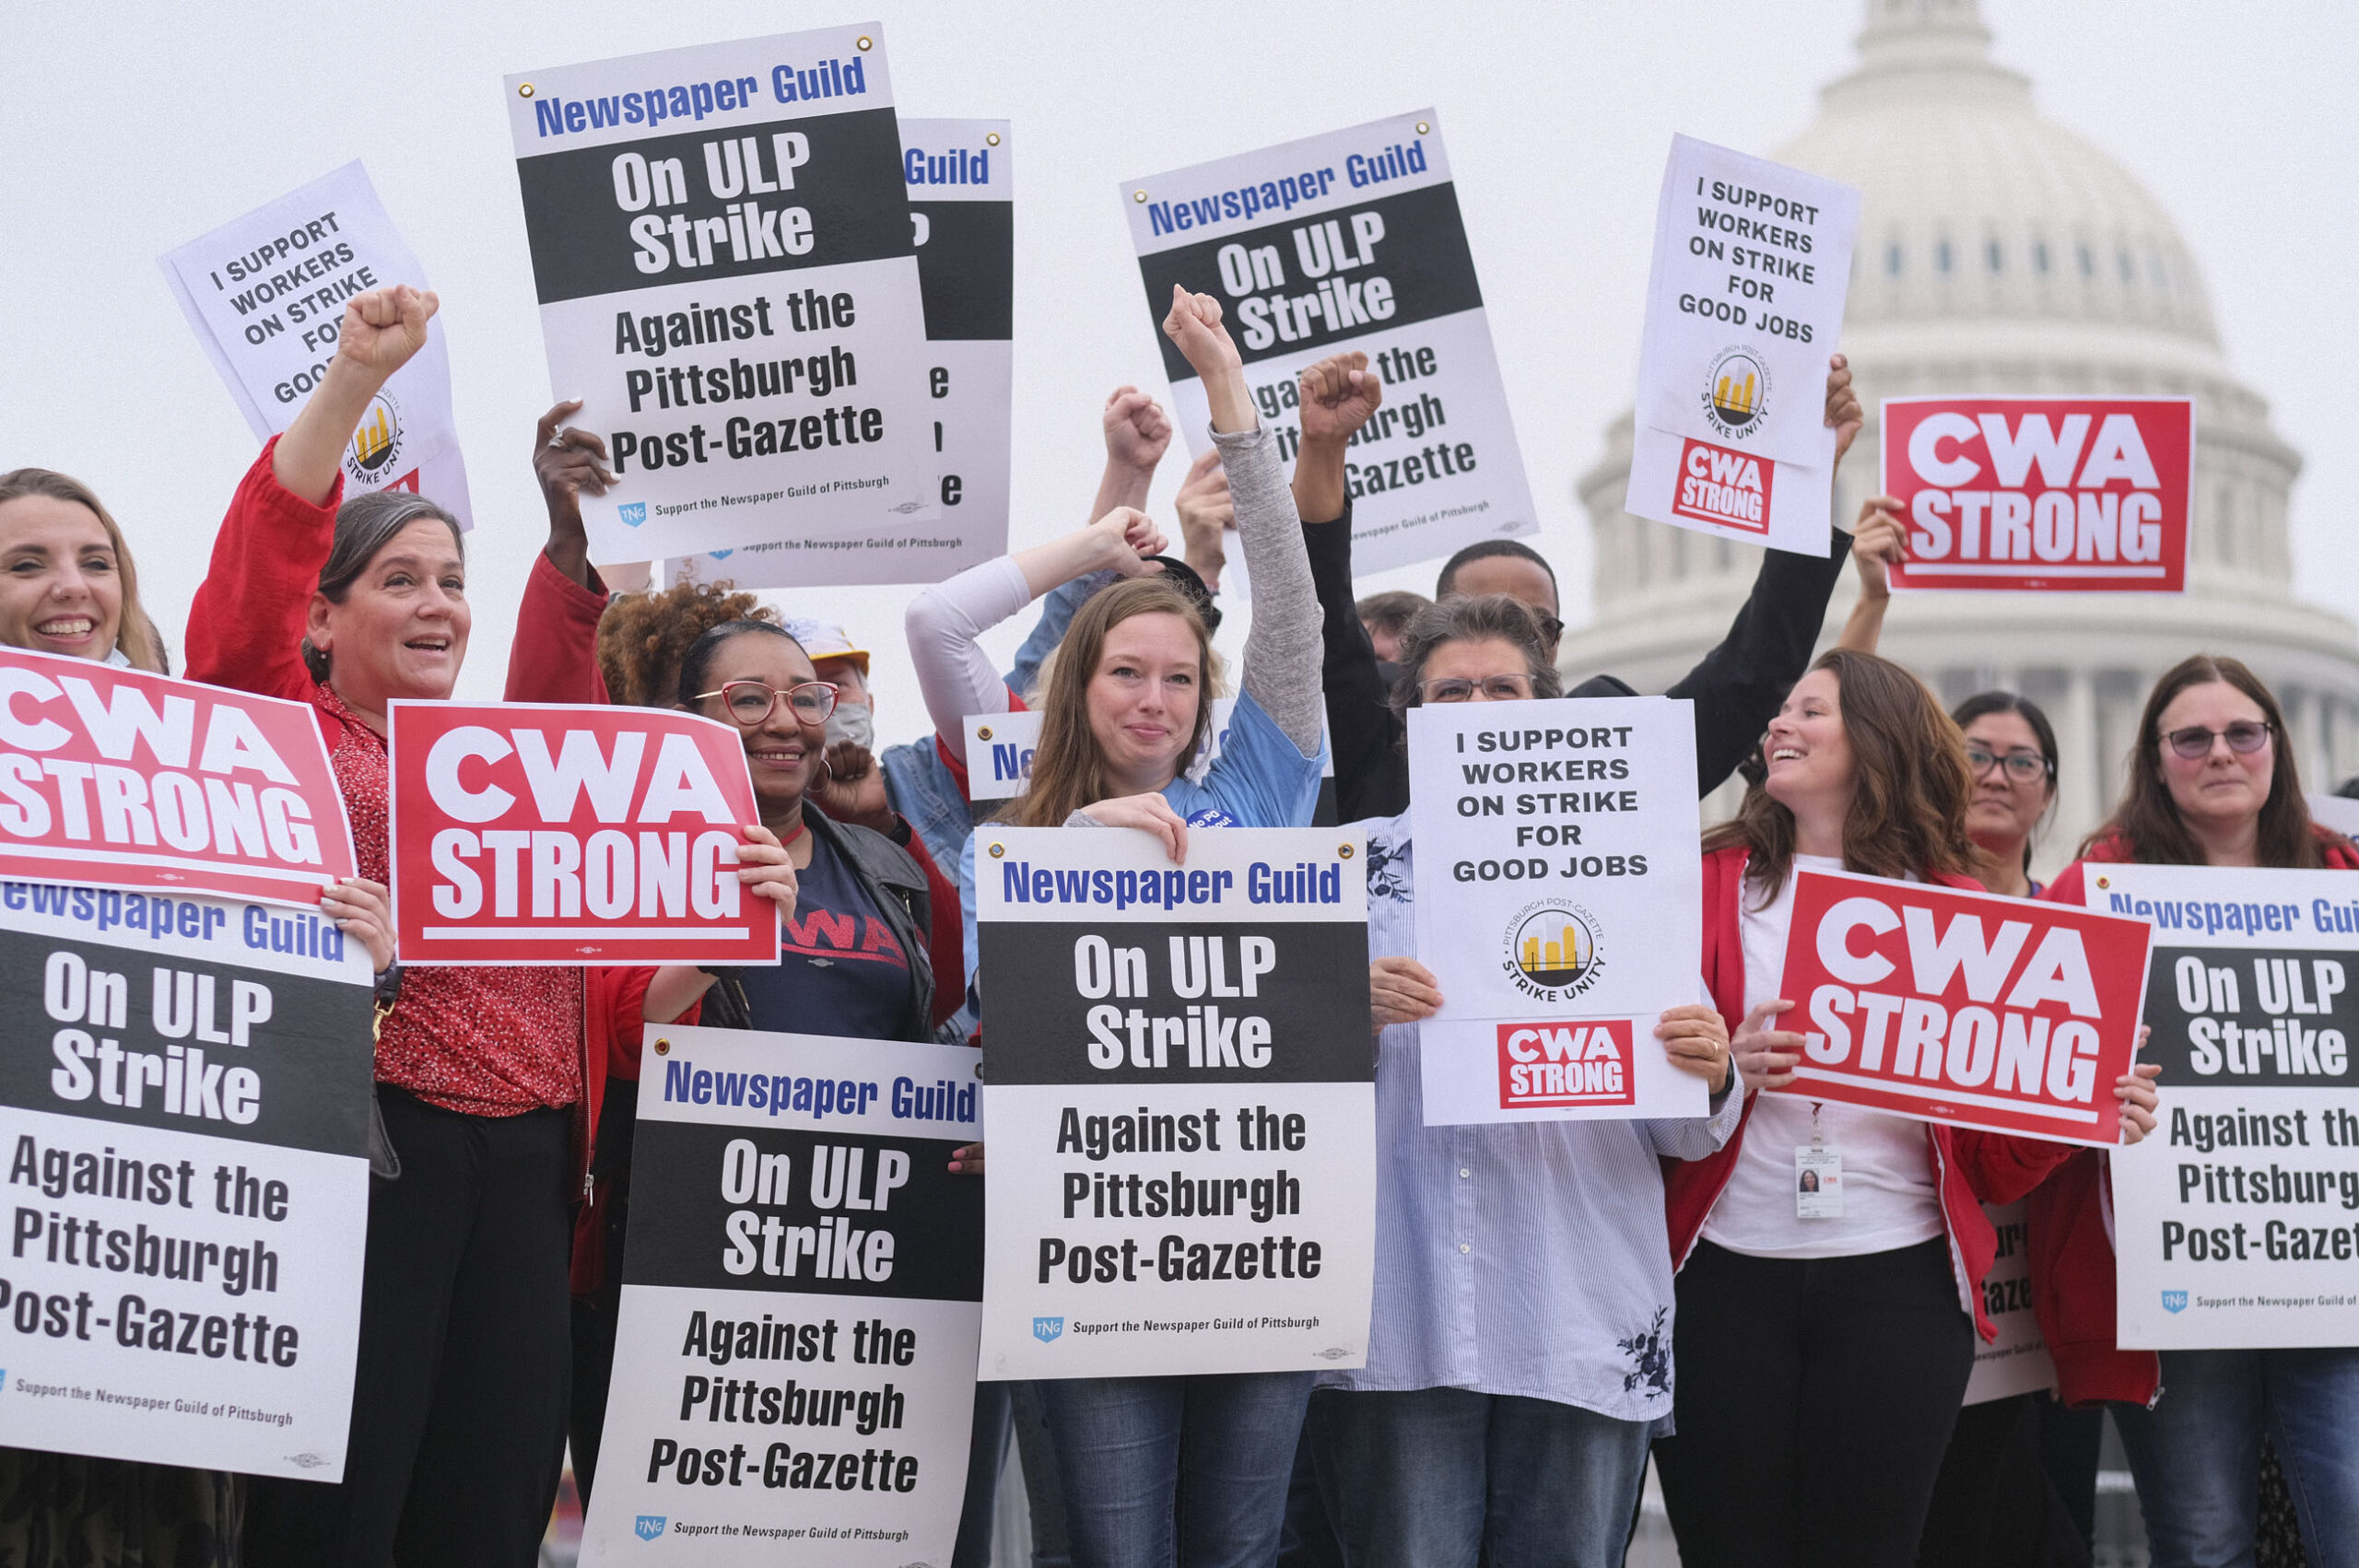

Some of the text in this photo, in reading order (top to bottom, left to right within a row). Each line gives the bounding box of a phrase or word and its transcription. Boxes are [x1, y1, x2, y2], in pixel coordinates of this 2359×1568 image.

[534, 56, 866, 138] Newspaper Guild
[612, 132, 811, 212] On ULP
[905, 148, 990, 184] Guild
[1147, 140, 1427, 237] Newspaper Guild
[1696, 177, 1819, 226] I SUPPORT
[209, 211, 340, 290] I SUPPORT
[630, 202, 815, 275] Strike
[1217, 211, 1385, 298] On ULP
[1697, 207, 1813, 253] WORKERS
[230, 242, 355, 315] WORKERS
[1689, 237, 1815, 286] ON STRIKE
[1728, 275, 1774, 303] FOR
[244, 266, 378, 345] ON STRIKE
[615, 289, 855, 357] Against the
[1237, 276, 1395, 350] Strike
[1679, 293, 1813, 344] GOOD JOBS
[275, 356, 337, 403] GOO
[626, 346, 857, 413] Pittsburgh
[1378, 345, 1438, 385] the
[612, 407, 884, 474] Post-Gazette
[1701, 392, 1768, 439] STRIKE UNITY
[346, 457, 380, 485] STRIKE
[383, 427, 404, 475] UNITY
[1344, 441, 1476, 499] Gazette
[1686, 446, 1764, 494] CWA
[1907, 413, 2161, 489] CWA
[621, 506, 645, 521] TNG
[656, 476, 890, 517] Support the Newspaper Guild of Pittsburgh
[1402, 516, 1427, 530] Guild
[1430, 512, 1439, 522] of
[1441, 501, 1489, 520] Pittsburgh
[1681, 479, 1764, 521] STRONG
[785, 540, 802, 550] the
[804, 539, 863, 551] Newspaper
[866, 538, 894, 549] Guild
[898, 538, 907, 548] of
[910, 538, 962, 551] Pittsburgh
[1911, 489, 2162, 562] STRONG
[0, 667, 300, 786] CWA
[1456, 726, 1633, 754] I SUPPORT
[426, 726, 737, 824] CWA
[1461, 759, 1629, 785] WORKERS
[0, 754, 323, 864] STRONG
[1457, 790, 1638, 817] ON STRIKE
[1517, 825, 1581, 848] FOR
[431, 829, 741, 919] STRONG
[1003, 861, 1341, 910] Newspaper Guild
[1452, 855, 1648, 882] GOOD JOBS
[4, 883, 344, 962] ewspaper Guild
[785, 908, 909, 965] WA
[1503, 897, 1603, 945] PITTSBURGH POST-GAZETTE
[2109, 894, 2359, 936] Newspaper Gui
[1074, 934, 1275, 999] On ULP
[1503, 956, 1605, 1002] STRIKE UNITY
[1816, 897, 2101, 1019] CWA
[2175, 954, 2345, 1015] On ULP
[44, 951, 273, 1047] On ULP
[1086, 1004, 1272, 1071] Strike
[1508, 1027, 1622, 1062] CWA
[1804, 984, 2099, 1104] STRONG
[2188, 1017, 2348, 1076] Strike
[51, 1028, 261, 1125] Strike
[663, 1060, 975, 1122] Newspaper Guild
[1509, 1061, 1623, 1094] STRONG
[1057, 1106, 1306, 1161] Against the
[2170, 1107, 2359, 1153] Against th
[9, 1135, 289, 1223] Against the
[721, 1139, 910, 1211] On ULP
[1063, 1170, 1299, 1223] Pittsburgh
[2178, 1163, 2359, 1210] Pittsburg
[13, 1208, 278, 1297] Pittsburgh
[723, 1211, 895, 1282] Strike
[1039, 1235, 1321, 1284] Post-Gazette
[1036, 1321, 1062, 1336] TNG
[1074, 1316, 1320, 1336] Support the Newspaper Guild of Pittsburgh
[2197, 1294, 2357, 1308] Support the Newspaper Guild of
[682, 1310, 915, 1366] Against the
[17, 1379, 293, 1427] Support the Newspaper Guild of Pittsburgh
[680, 1375, 905, 1435] Pittsburgh
[647, 1438, 918, 1493] Post-Gazette
[638, 1519, 663, 1536] TNG
[675, 1522, 909, 1544] Support the Newspaper Guild of Pittsburgh
